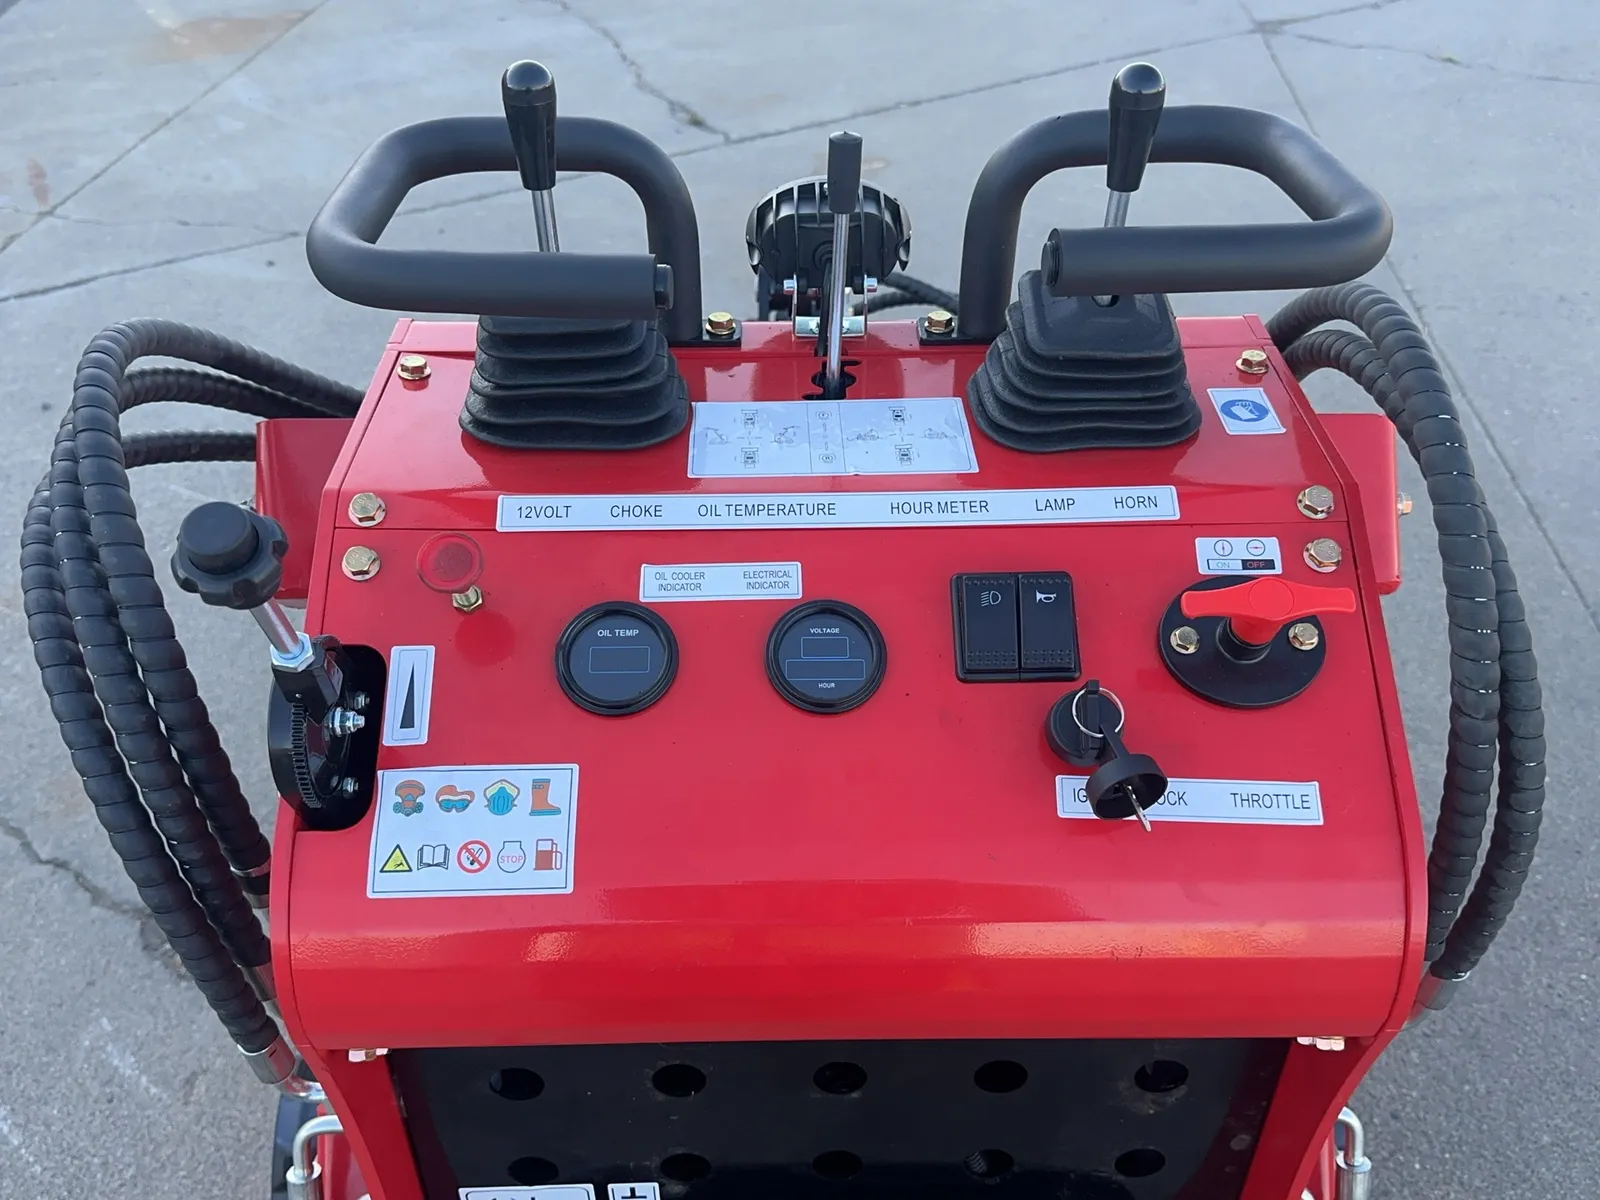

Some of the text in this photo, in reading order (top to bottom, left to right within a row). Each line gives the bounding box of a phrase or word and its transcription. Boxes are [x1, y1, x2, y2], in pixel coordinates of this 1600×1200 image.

[890, 500, 989, 514] HOUR METER
[1035, 498, 1076, 512] LAMP
[1114, 495, 1158, 509] HORN
[516, 506, 572, 518] 12VOLT
[610, 504, 663, 518] CHOKE
[698, 502, 836, 517] OIL TEMPERATURE
[654, 571, 706, 581] OIL COOLER
[743, 570, 792, 580] ELECTRICAL
[658, 582, 702, 592] INDICATOR
[746, 580, 790, 590] INDICATOR
[597, 628, 640, 637] OIL TEMP
[1156, 790, 1188, 806] OCK
[1230, 792, 1311, 810] THROTTLE
[500, 855, 523, 863] STOP
